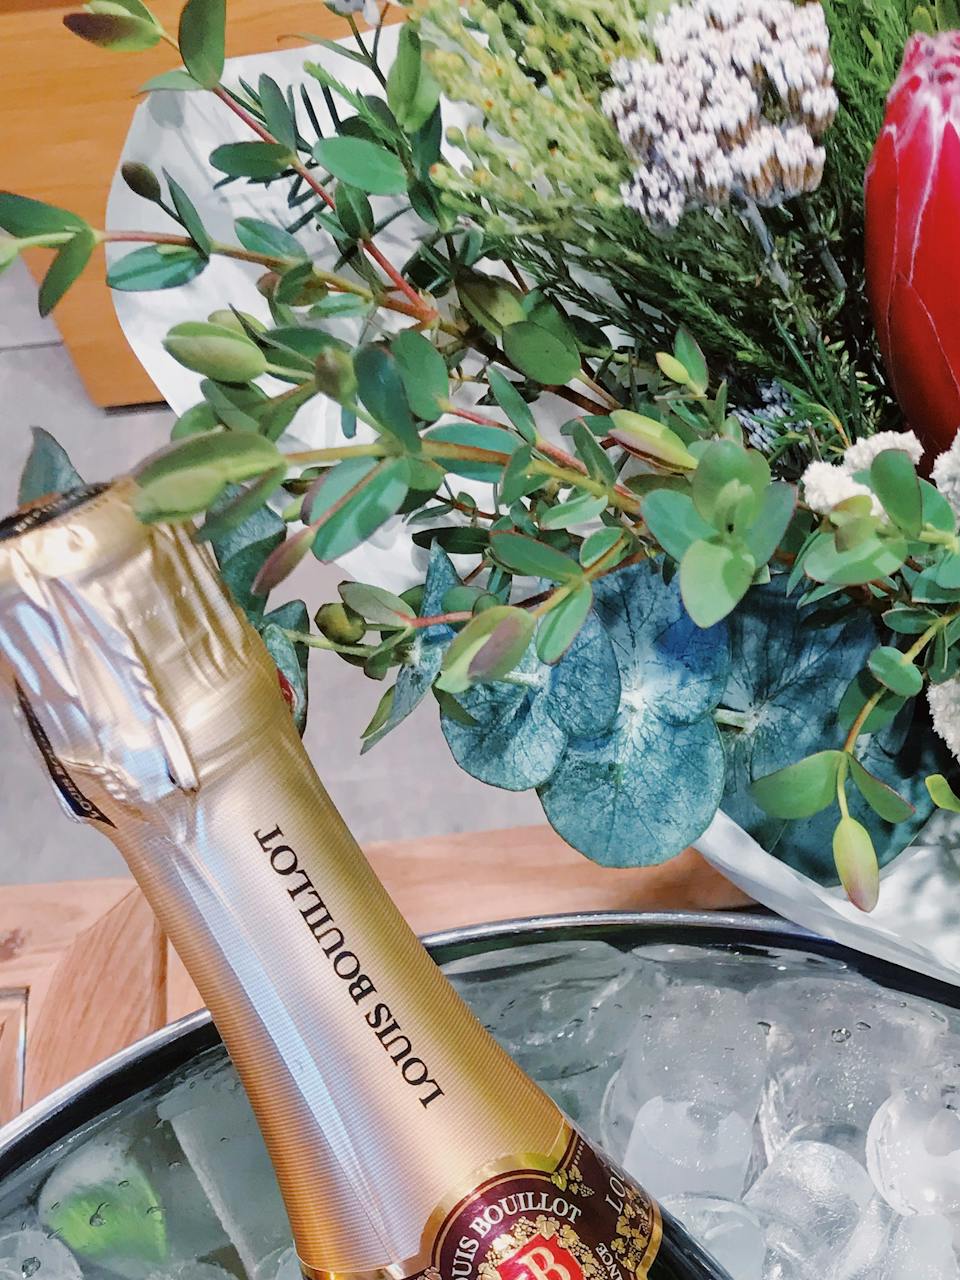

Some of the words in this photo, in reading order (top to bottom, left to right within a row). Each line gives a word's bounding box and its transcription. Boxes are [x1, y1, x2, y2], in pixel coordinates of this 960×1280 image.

[254, 824, 377, 1005] BOUILLOT
[364, 1003, 445, 1109] LOUIS
[469, 1192, 581, 1239] BOUILLOT
